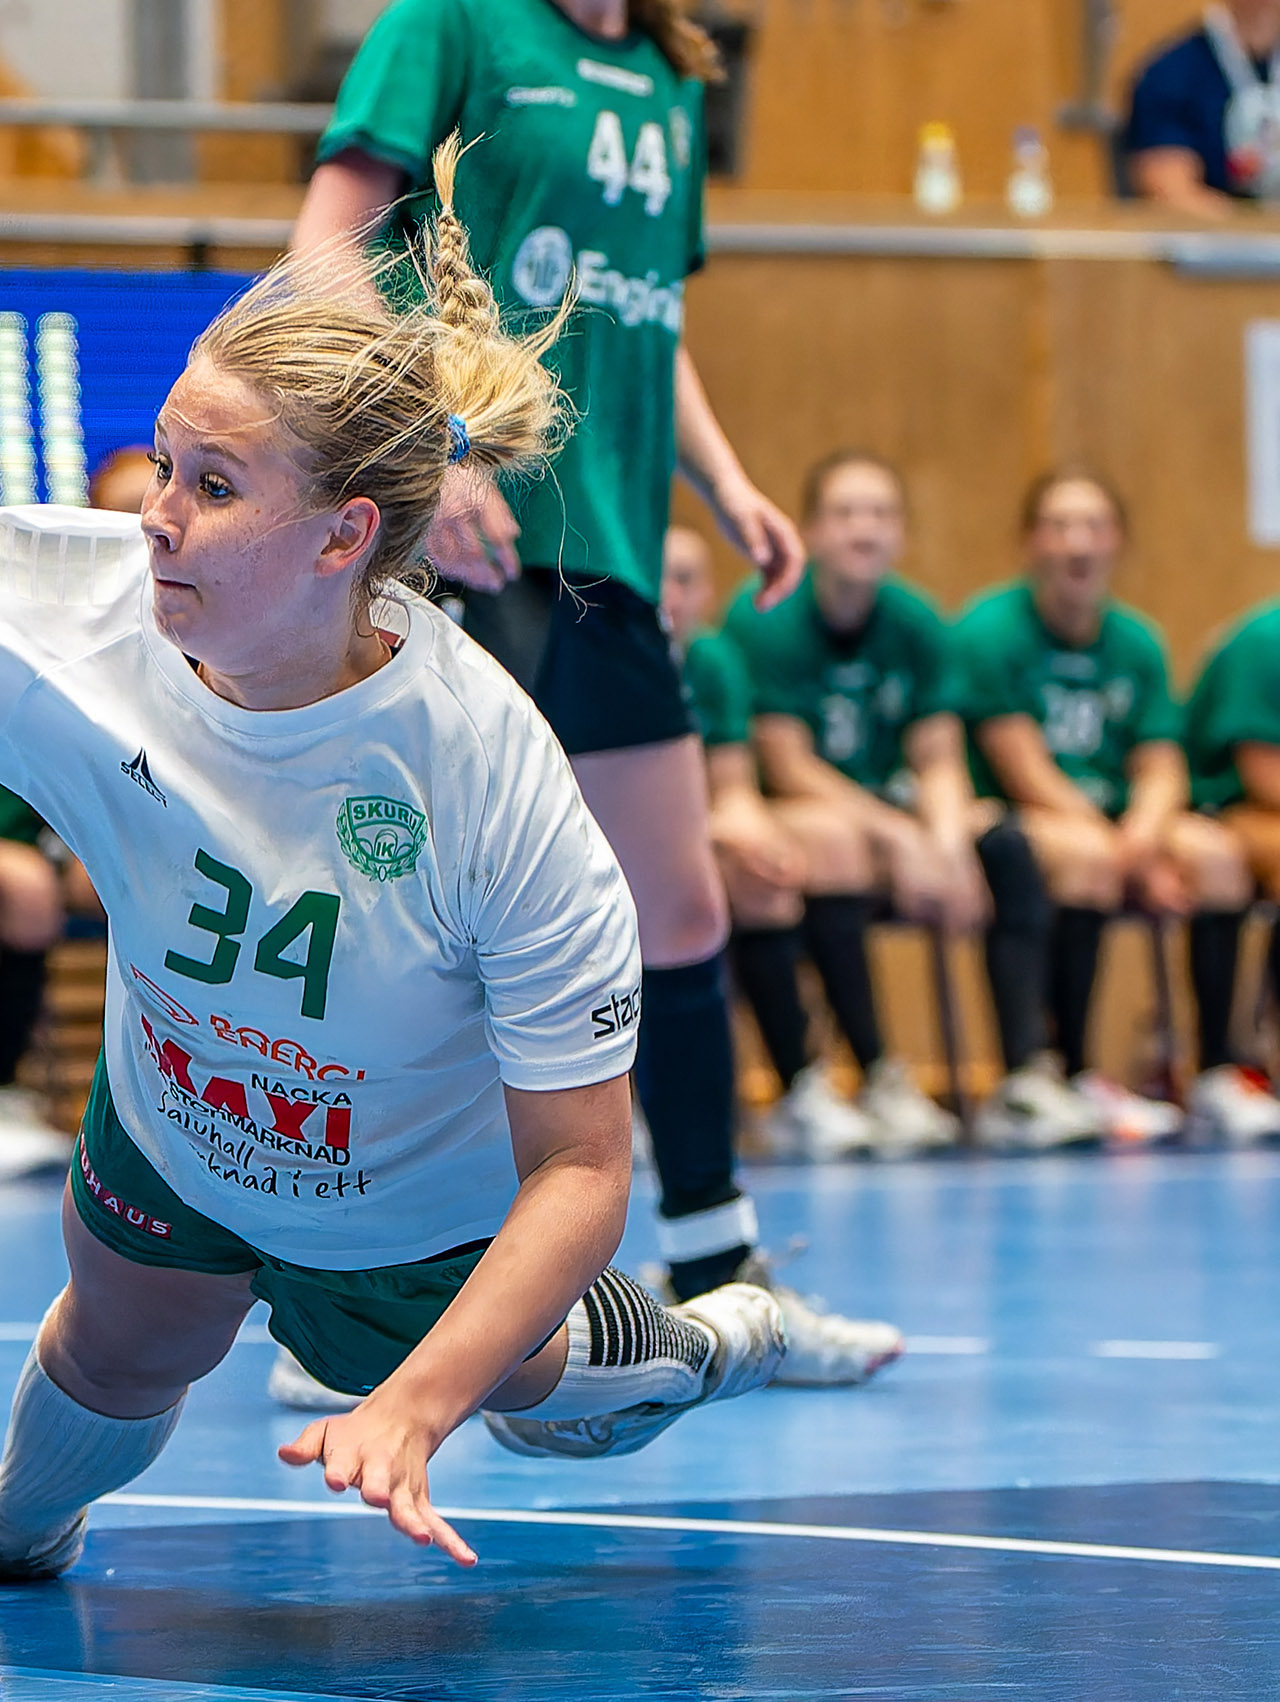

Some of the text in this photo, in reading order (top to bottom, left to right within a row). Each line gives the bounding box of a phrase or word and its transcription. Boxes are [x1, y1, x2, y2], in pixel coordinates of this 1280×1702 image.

[587, 109, 671, 217] 44
[353, 802, 417, 830] SKURU
[376, 841, 395, 858] IK
[164, 847, 341, 1021] 34
[251, 1073, 352, 1106] NACKA
[81, 1132, 168, 1235] UHAUS
[287, 1169, 302, 1198] i
[315, 1169, 372, 1199] ett
